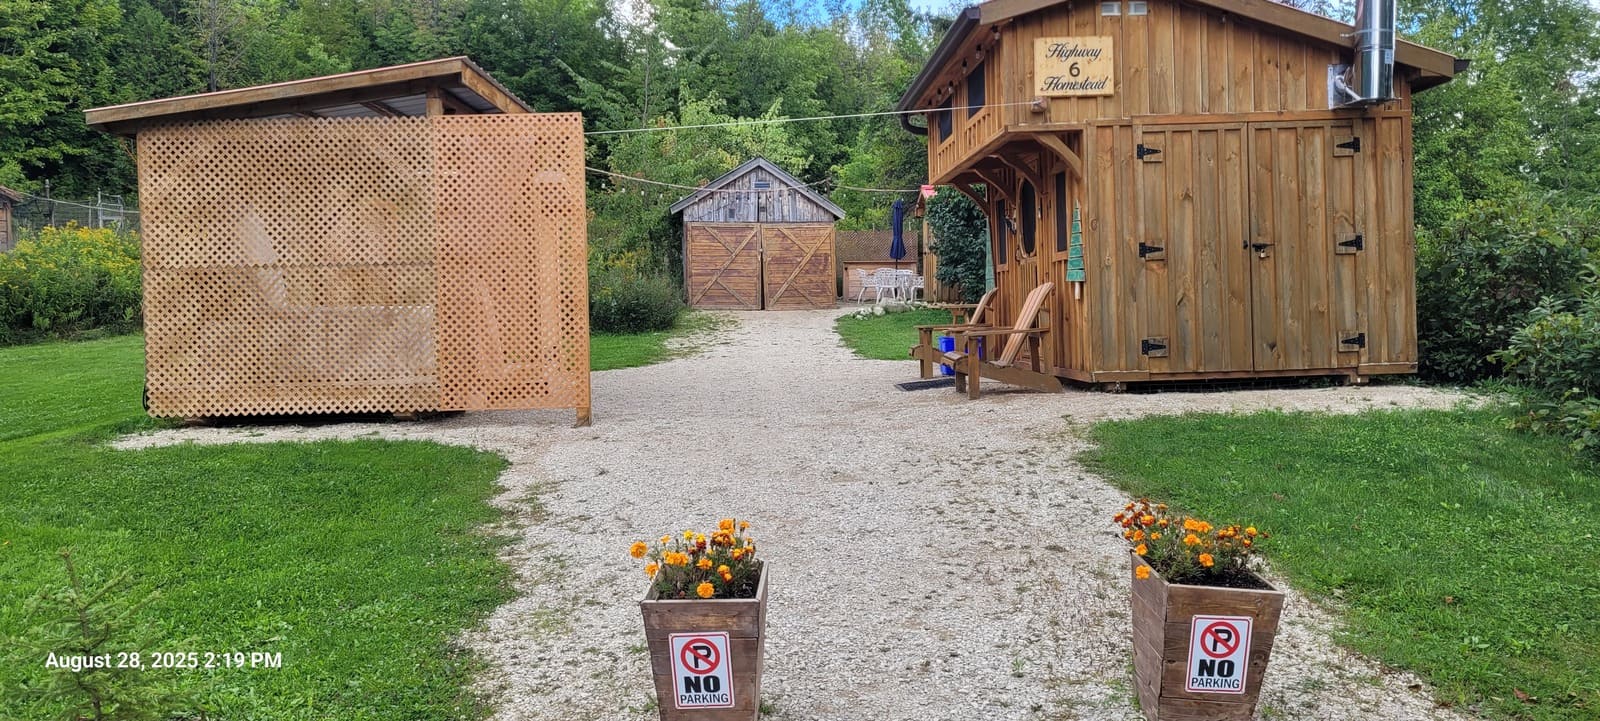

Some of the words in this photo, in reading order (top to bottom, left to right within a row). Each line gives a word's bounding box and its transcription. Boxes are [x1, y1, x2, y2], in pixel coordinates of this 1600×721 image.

[1046, 42, 1101, 62] Highway
[1069, 61, 1080, 77] 6
[1040, 75, 1108, 91] Homestead
[1212, 628, 1232, 652] P
[692, 645, 712, 669] P
[1198, 658, 1235, 678] NO
[683, 675, 721, 694] NO
[1191, 677, 1240, 689] PARKING
[680, 693, 729, 704] PARKING
